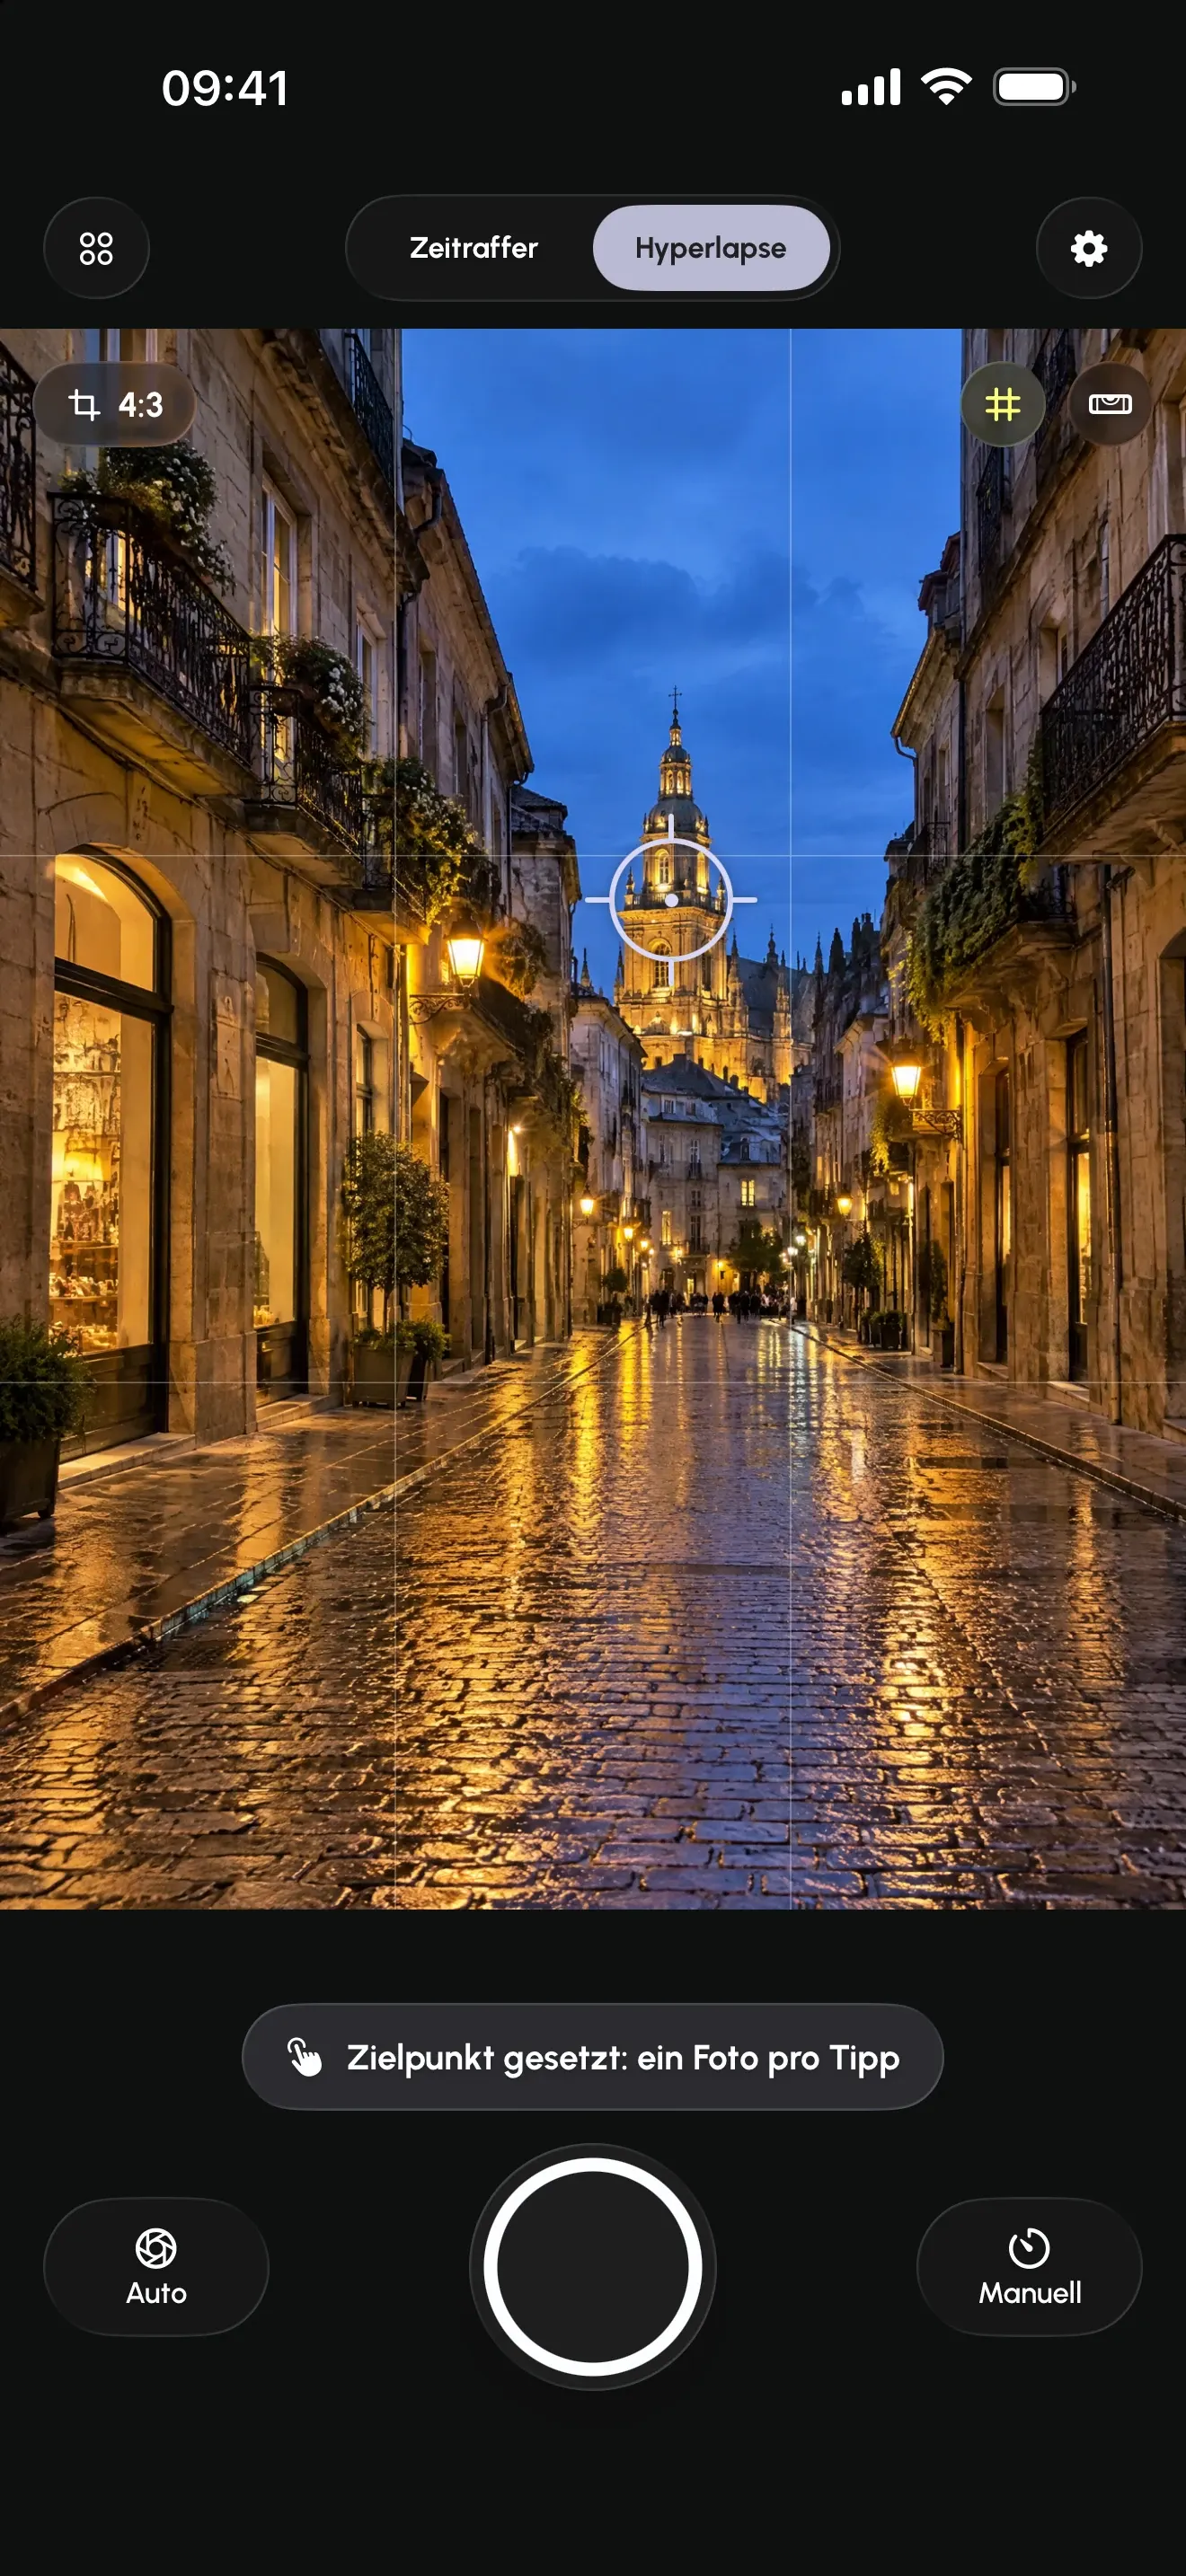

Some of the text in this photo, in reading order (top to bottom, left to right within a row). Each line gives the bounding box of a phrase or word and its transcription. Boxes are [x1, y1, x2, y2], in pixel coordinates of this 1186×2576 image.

[162, 69, 286, 107] 09:41
[410, 234, 539, 260] Zeitraffer
[636, 234, 787, 266] Hyperlapse
[118, 391, 164, 419] 4:3
[347, 2042, 900, 2079] Zielpunkt gesetzt: ein Foto pro Tipp
[125, 2281, 188, 2305] Auto
[978, 2280, 1082, 2305] Manuell
